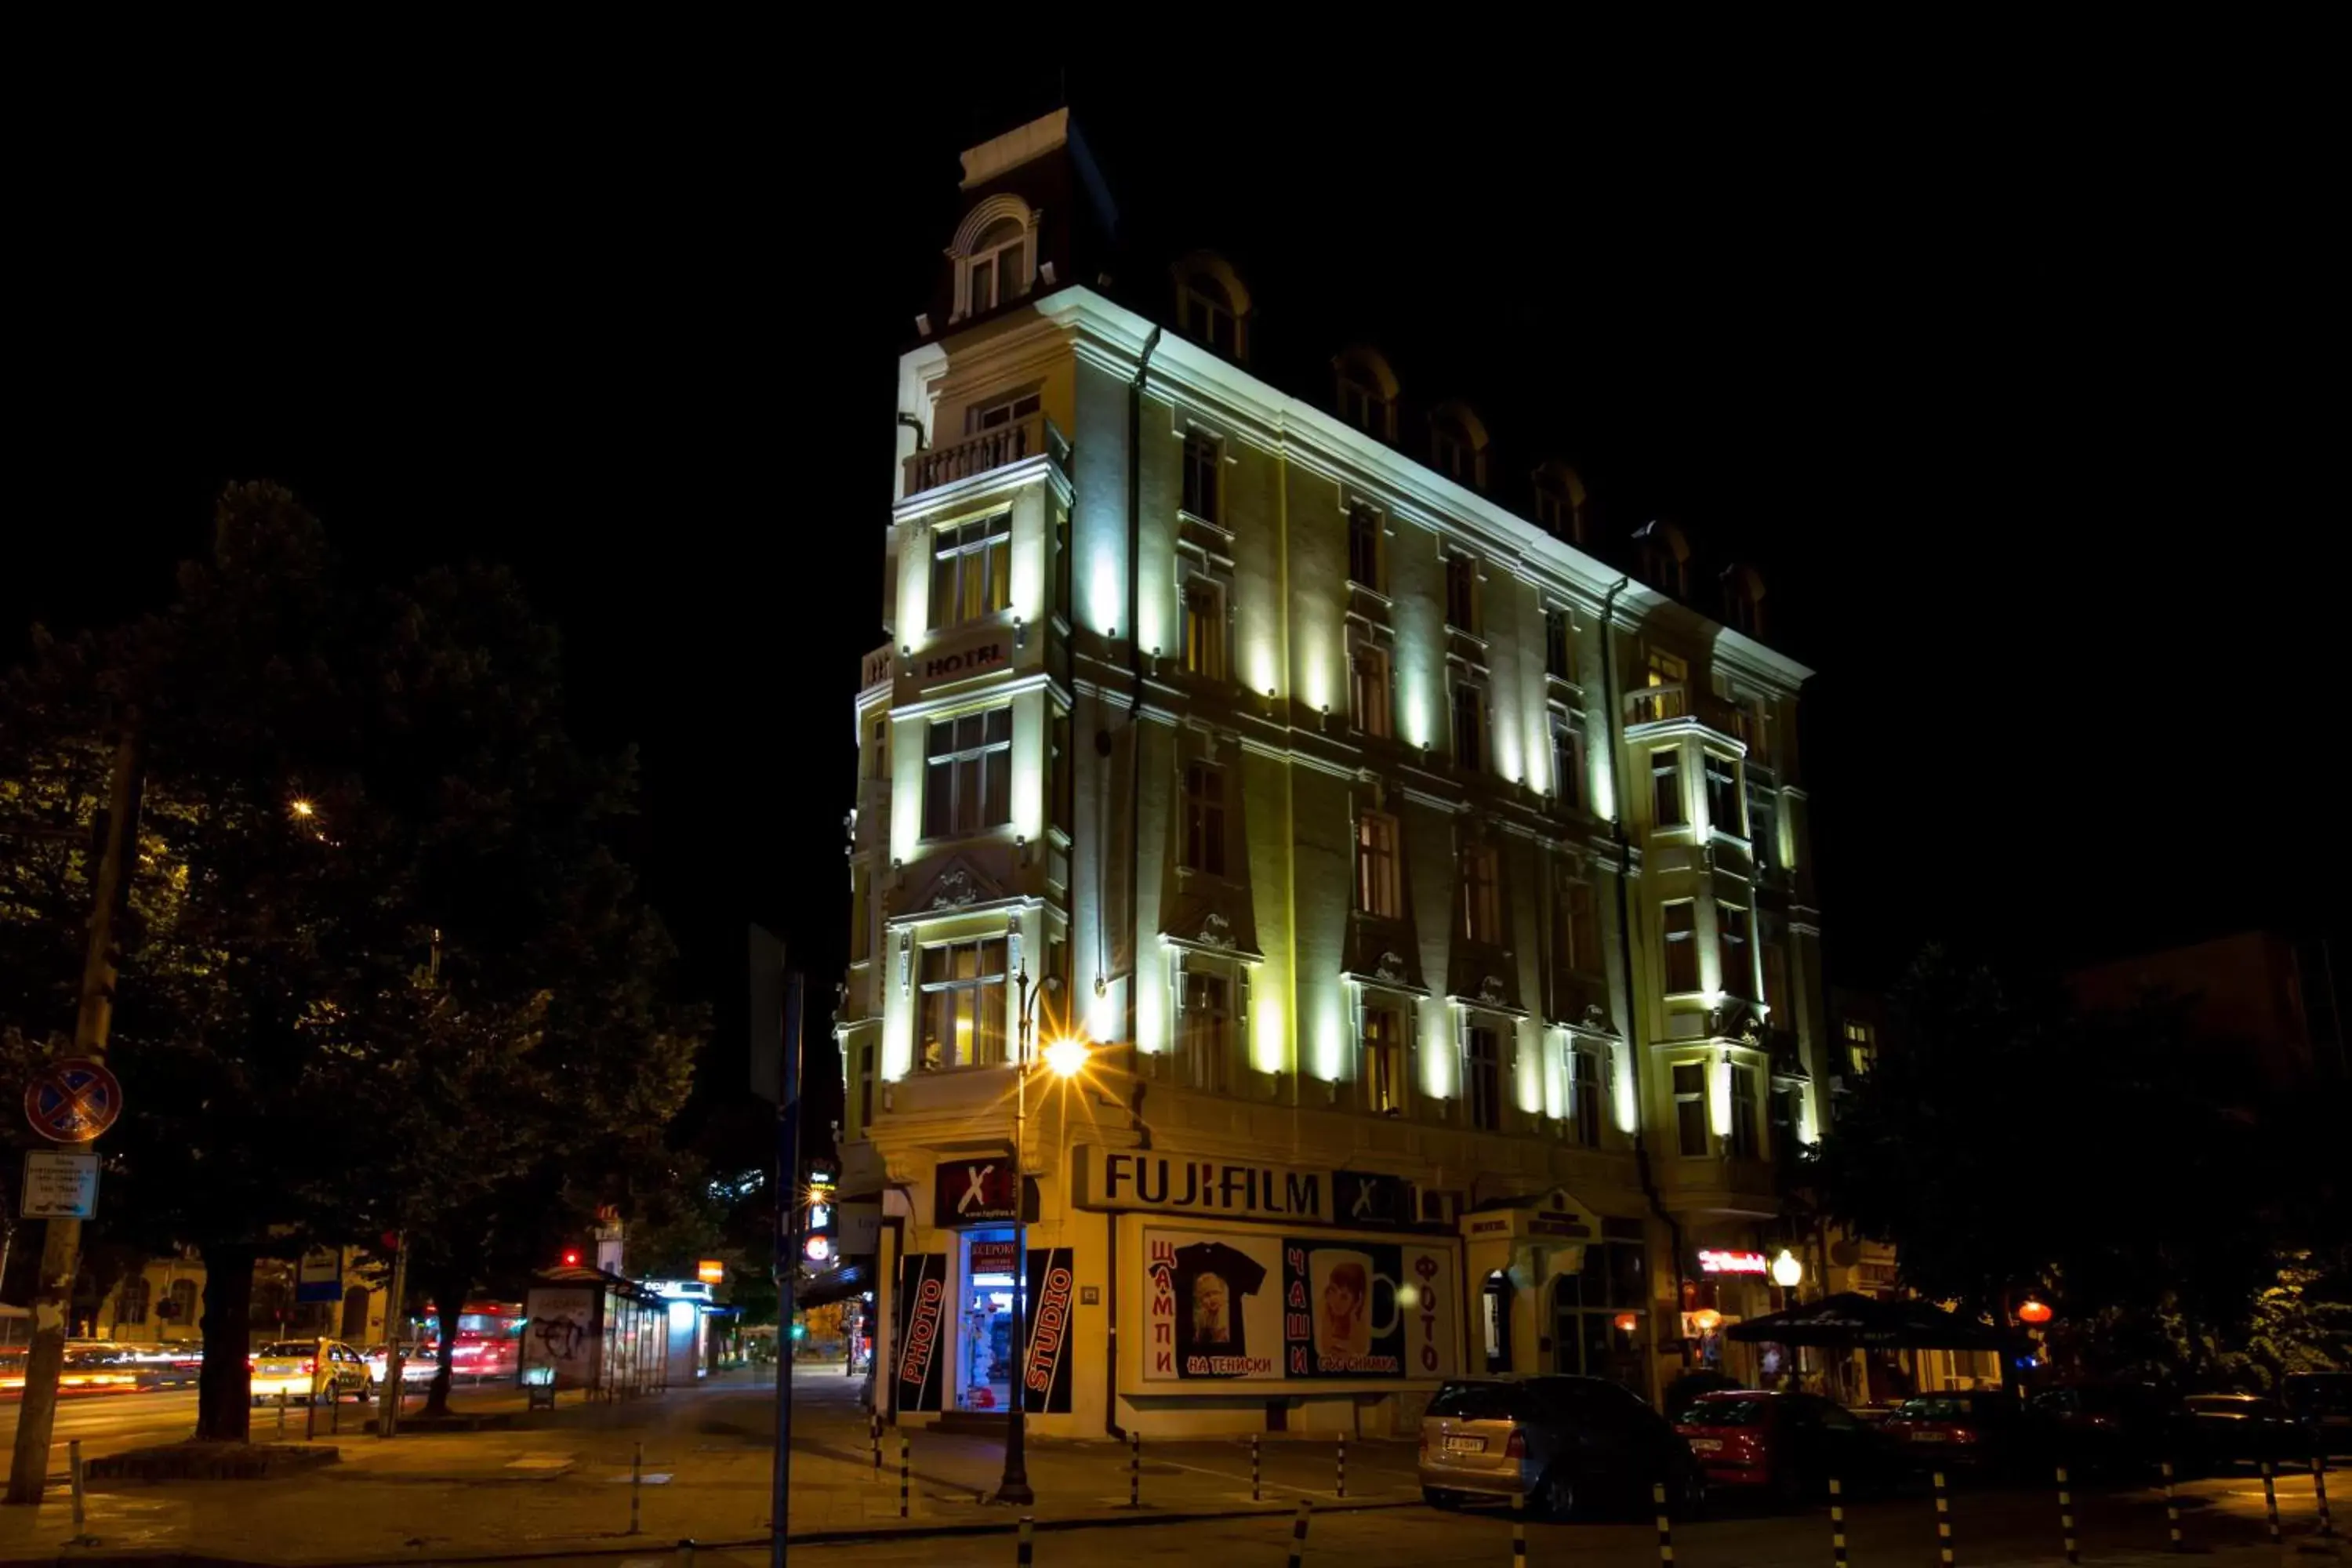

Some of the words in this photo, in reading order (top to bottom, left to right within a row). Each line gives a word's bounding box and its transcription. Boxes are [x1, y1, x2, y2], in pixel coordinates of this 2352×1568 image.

[927, 644, 1004, 677] HOTEL
[1106, 1153, 1319, 1214] FUJIFILM
[902, 1279, 942, 1385] PHOTO
[1026, 1268, 1073, 1392] STUDIO
[1151, 1240, 1175, 1373] ЩАМПИ
[1287, 1247, 1310, 1374] ЧАШИ
[1414, 1255, 1439, 1372] ФОТО
[1188, 1356, 1209, 1374] НА
[1210, 1356, 1272, 1376] ТЕНИСКИ
[1345, 1356, 1398, 1373] СНИМКА
